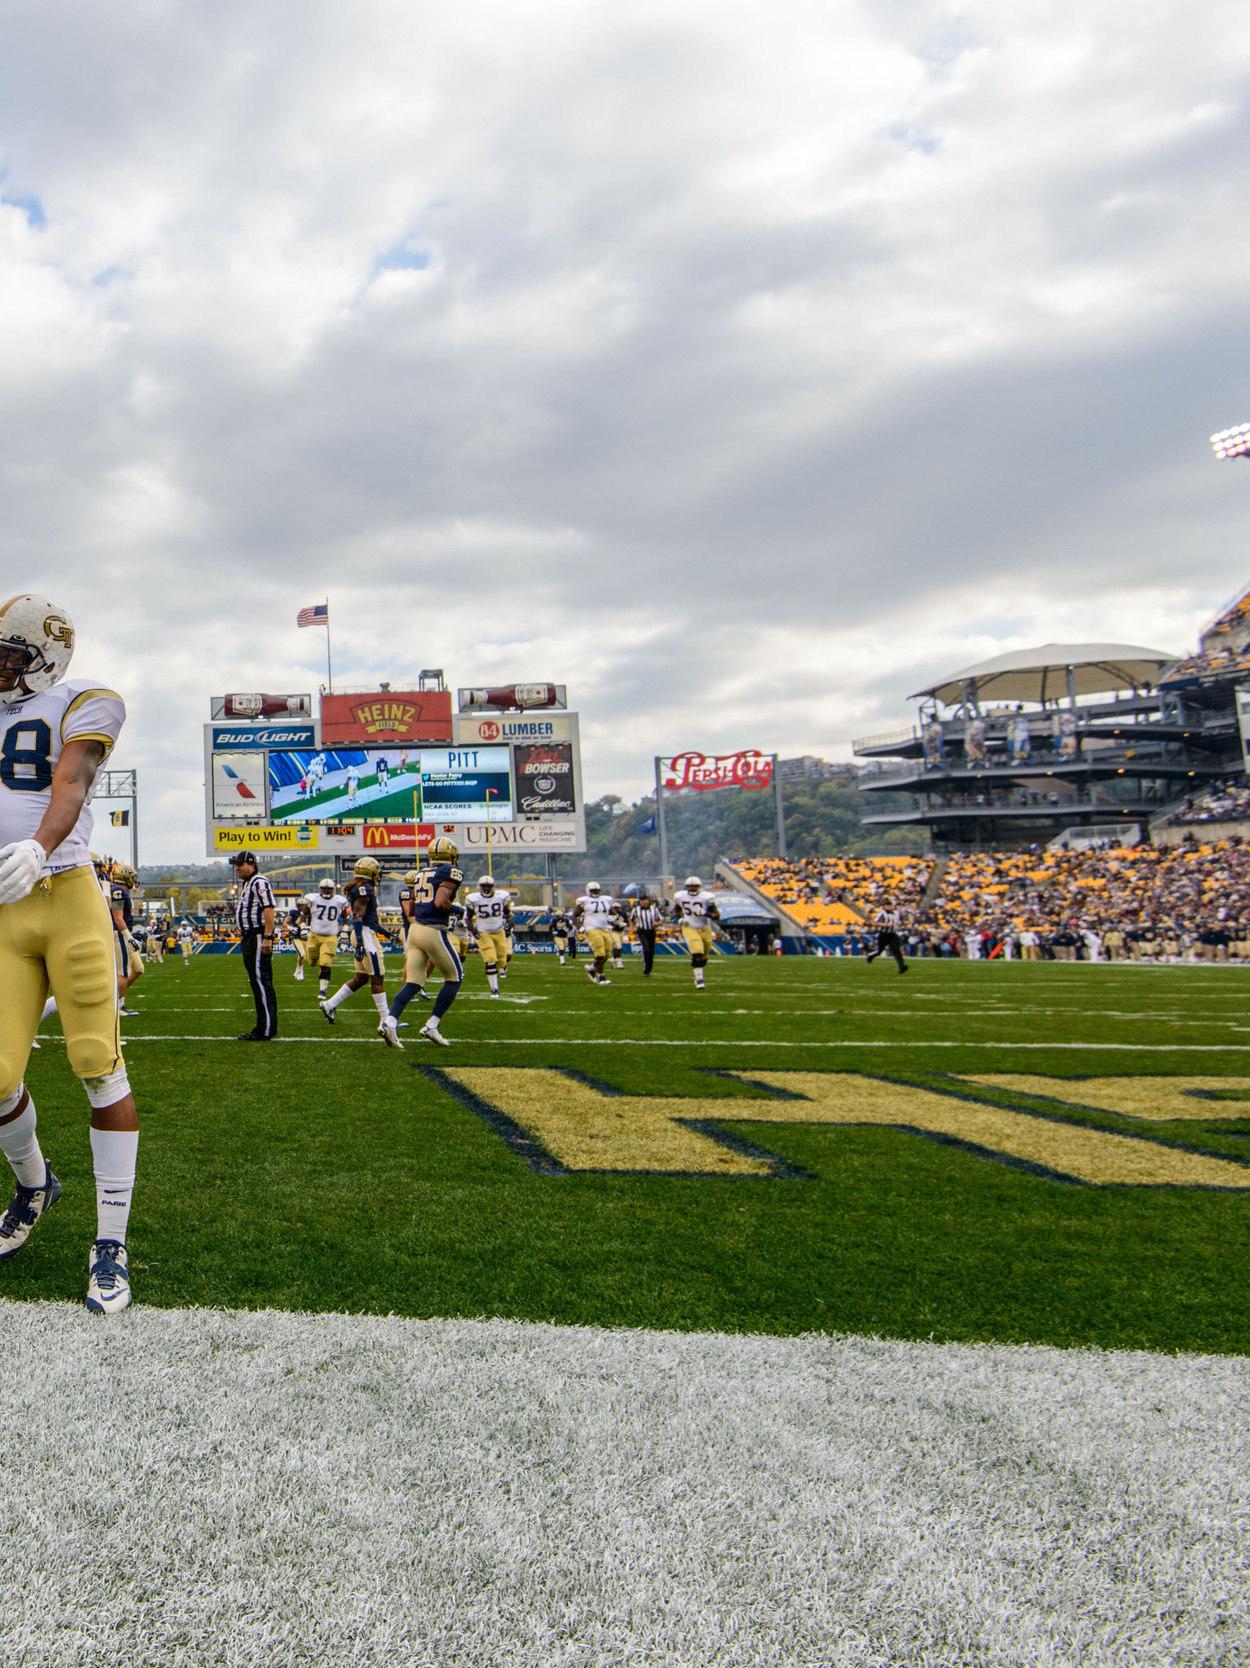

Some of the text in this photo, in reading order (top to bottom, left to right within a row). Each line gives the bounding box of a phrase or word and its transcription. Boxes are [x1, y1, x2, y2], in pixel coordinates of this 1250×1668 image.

[356, 703, 416, 724] HEINZ
[480, 722, 554, 738] 84 LUMBER
[216, 732, 312, 744] BUD LIGHT
[448, 751, 479, 768] PITT
[524, 762, 570, 775] BOWSER
[521, 796, 571, 810] Cadillac
[331, 826, 354, 835] 11:04
[443, 825, 455, 833] 25
[466, 826, 536, 844] UPMC
[219, 831, 291, 845] Play to Win!
[316, 904, 338, 922] 70
[478, 902, 502, 919] 58
[591, 901, 607, 914] 71
[682, 901, 704, 917] 53
